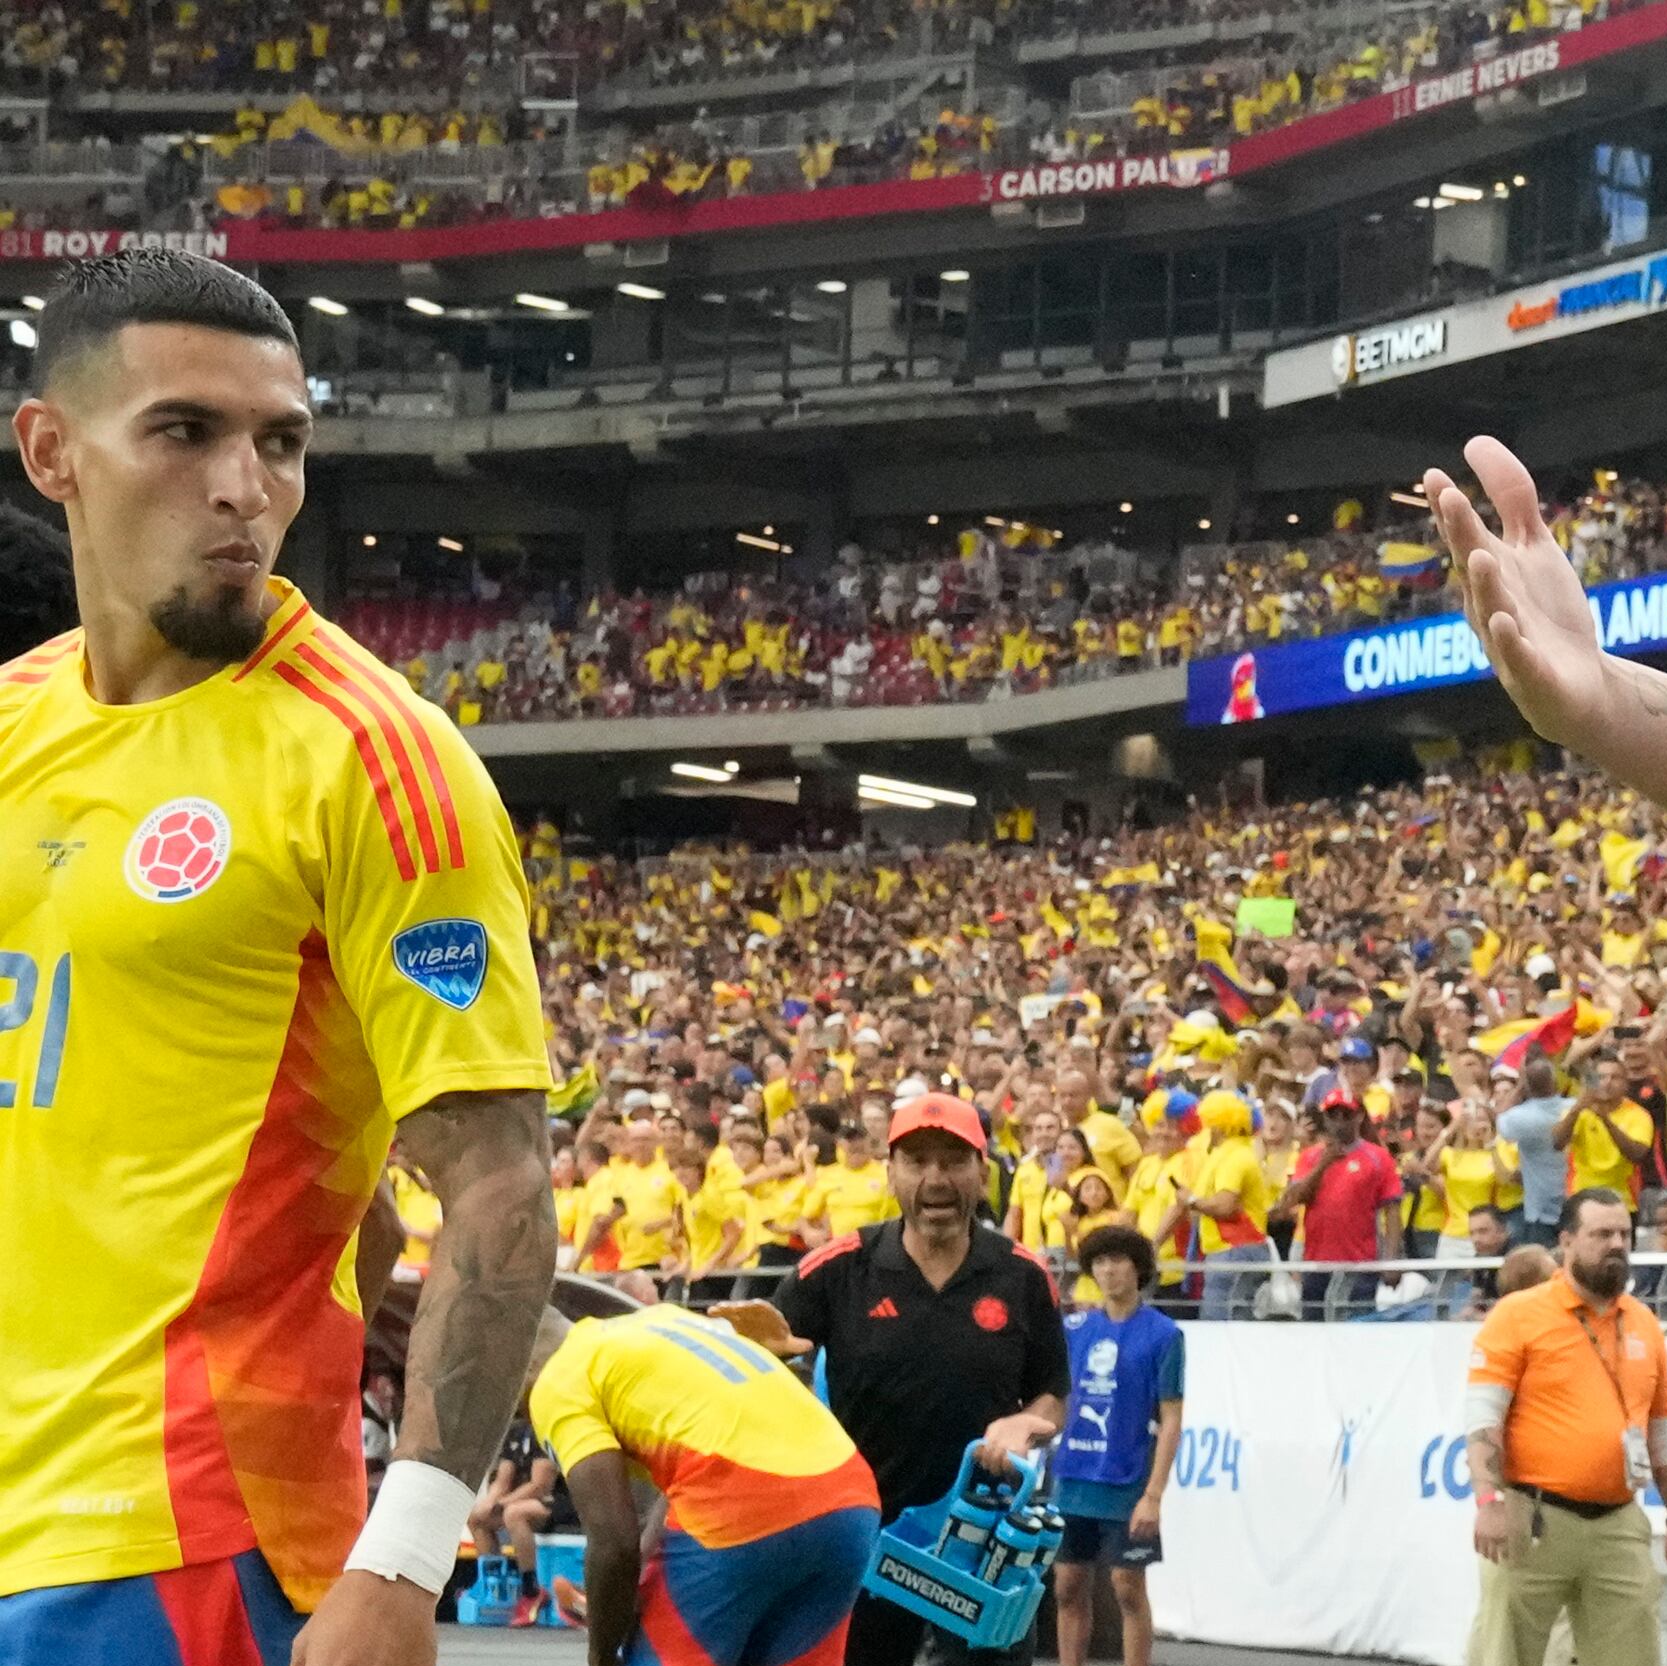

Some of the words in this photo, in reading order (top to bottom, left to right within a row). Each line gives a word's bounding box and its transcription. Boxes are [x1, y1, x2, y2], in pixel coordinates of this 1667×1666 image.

[1415, 68, 1475, 111] ERNIE
[1476, 40, 1560, 92] NEVERS
[999, 161, 1117, 198] CARSON
[43, 229, 109, 258] ROY
[1355, 318, 1445, 373] BETMGM
[407, 943, 476, 967] VIBRA
[879, 1556, 980, 1622] POWERADE
